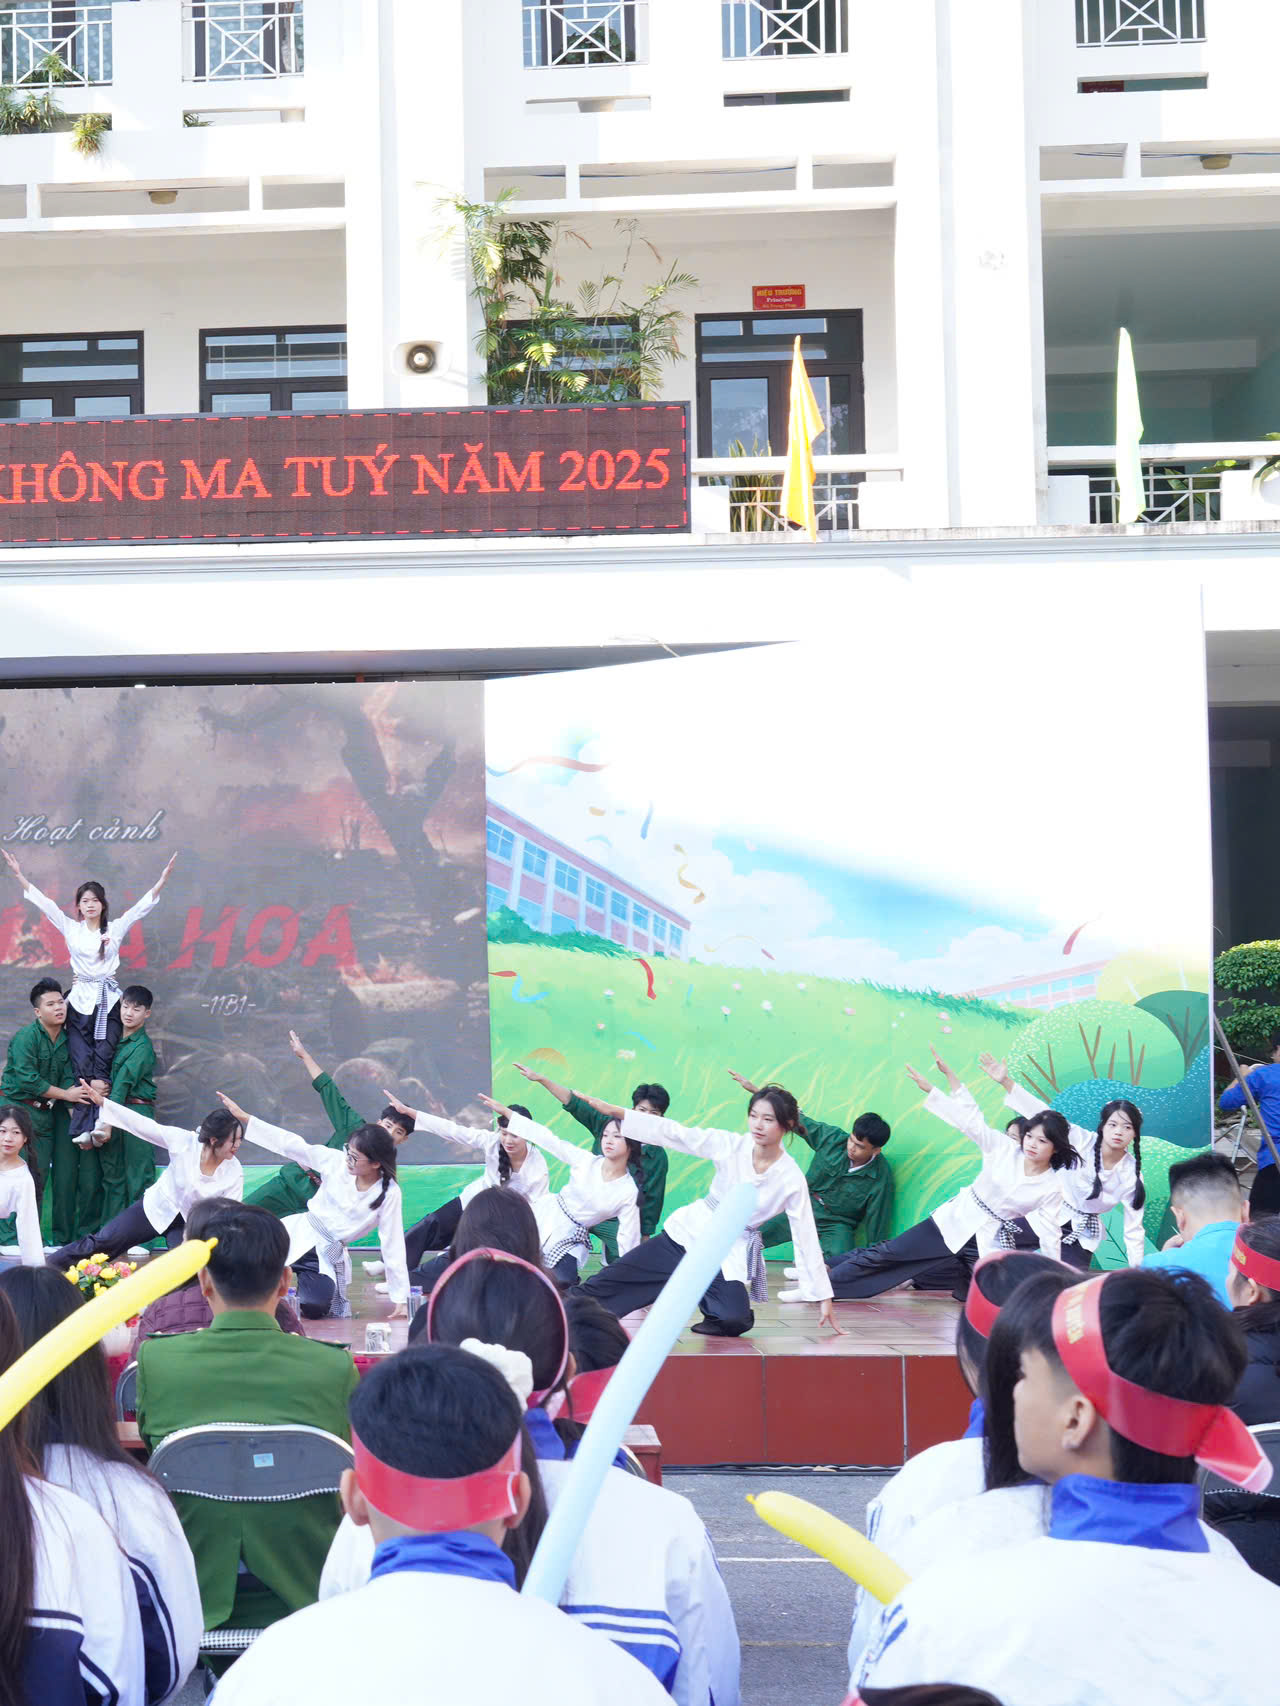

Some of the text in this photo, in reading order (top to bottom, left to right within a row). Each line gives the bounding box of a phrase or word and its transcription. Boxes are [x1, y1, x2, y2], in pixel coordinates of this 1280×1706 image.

[181, 458, 272, 499] MA
[284, 443, 400, 497] TUÝ
[410, 443, 545, 494] NĂM
[559, 449, 670, 491] 2025
[3, 809, 164, 845] Hoạt cảnh
[167, 902, 360, 970] HOA
